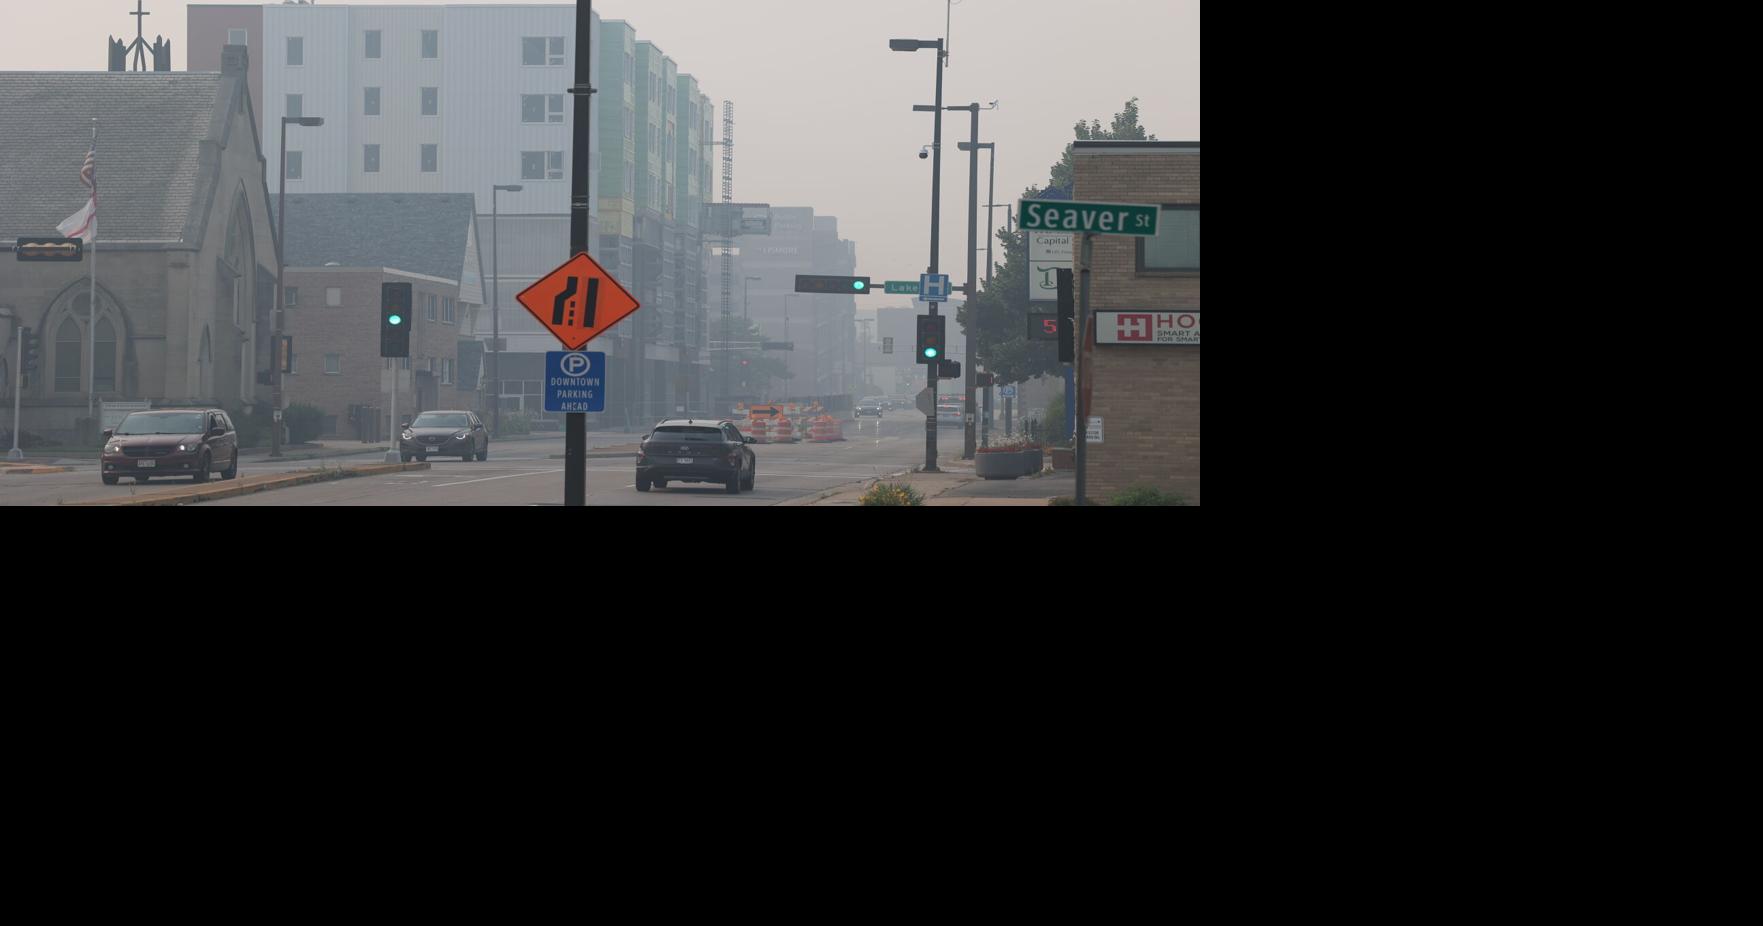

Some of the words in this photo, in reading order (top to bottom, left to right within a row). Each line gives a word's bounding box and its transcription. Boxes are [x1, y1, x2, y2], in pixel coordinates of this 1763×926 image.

[1026, 203, 1129, 231] Seaver
[1135, 214, 1150, 228] St
[1036, 235, 1069, 246] Capital
[891, 282, 919, 293] Lake
[923, 275, 945, 295] H
[1043, 319, 1057, 334] 5
[1157, 314, 1200, 328] HO
[569, 357, 584, 372] P
[551, 377, 600, 387] DOWNTOWN
[557, 390, 593, 399] PARKING
[561, 402, 588, 411] AHEAD
